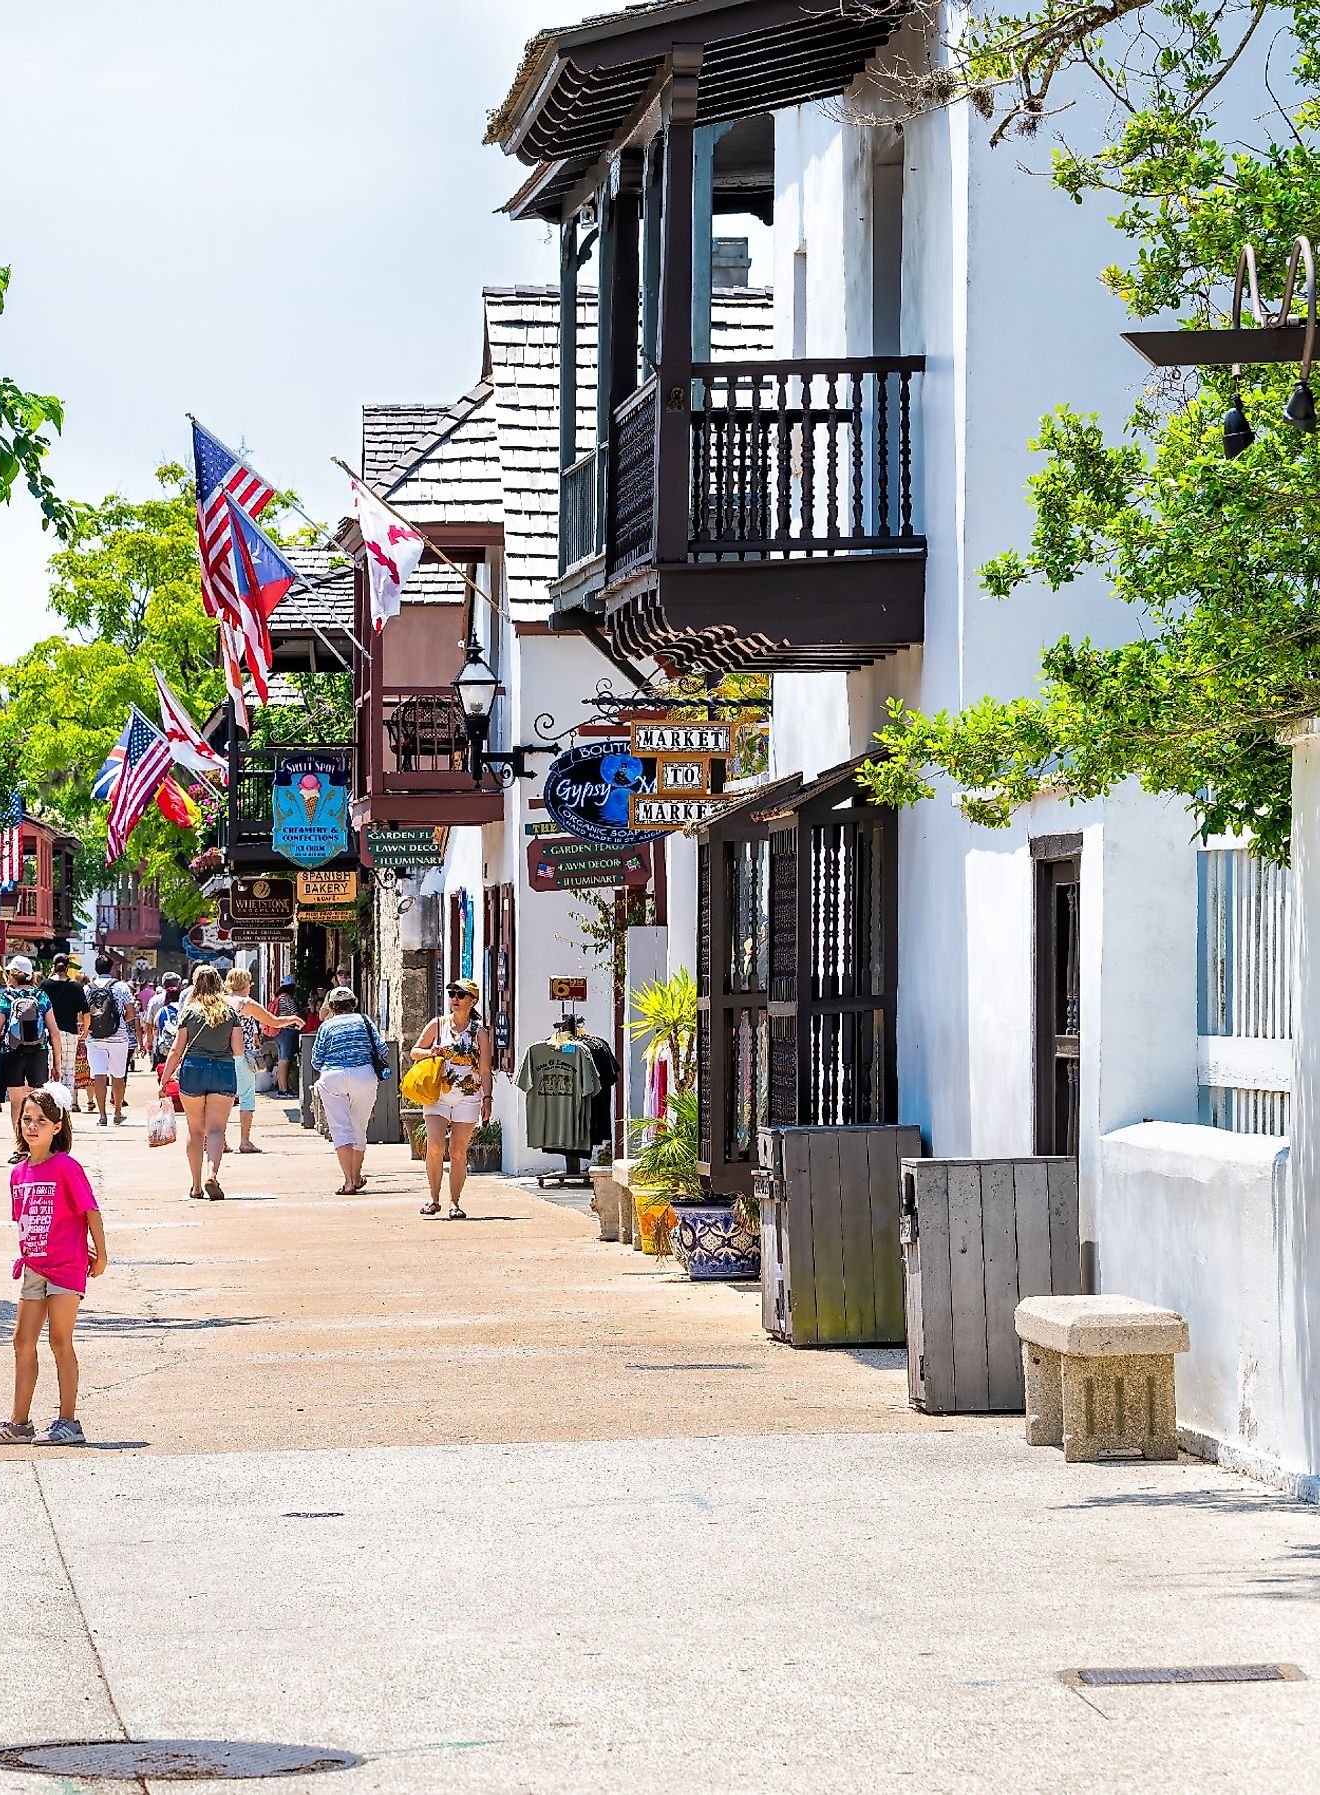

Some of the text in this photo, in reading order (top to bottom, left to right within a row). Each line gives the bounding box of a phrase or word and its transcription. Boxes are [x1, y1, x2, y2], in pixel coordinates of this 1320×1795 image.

[642, 730, 723, 747] MARKET
[580, 741, 631, 759] BOUTI
[314, 761, 336, 774] SPOT
[670, 768, 696, 783] TO
[556, 778, 612, 808] Gypsy
[642, 804, 715, 820] MARKE
[532, 822, 557, 834] THE
[562, 809, 608, 836] ORGANIC
[282, 826, 327, 834] CREAMERY
[370, 831, 415, 840] GARDEN
[282, 834, 340, 842] CONFECTIONS
[375, 844, 441, 853] LAWN DECO
[550, 843, 592, 855] GARDEN
[380, 857, 442, 865] ILLUMINART
[560, 858, 619, 872] LAWN DECOR
[302, 871, 350, 881] SPANISH
[563, 874, 617, 887] ILLUMINART
[305, 883, 348, 893] BAKERY
[235, 899, 290, 909] WHETSTONE
